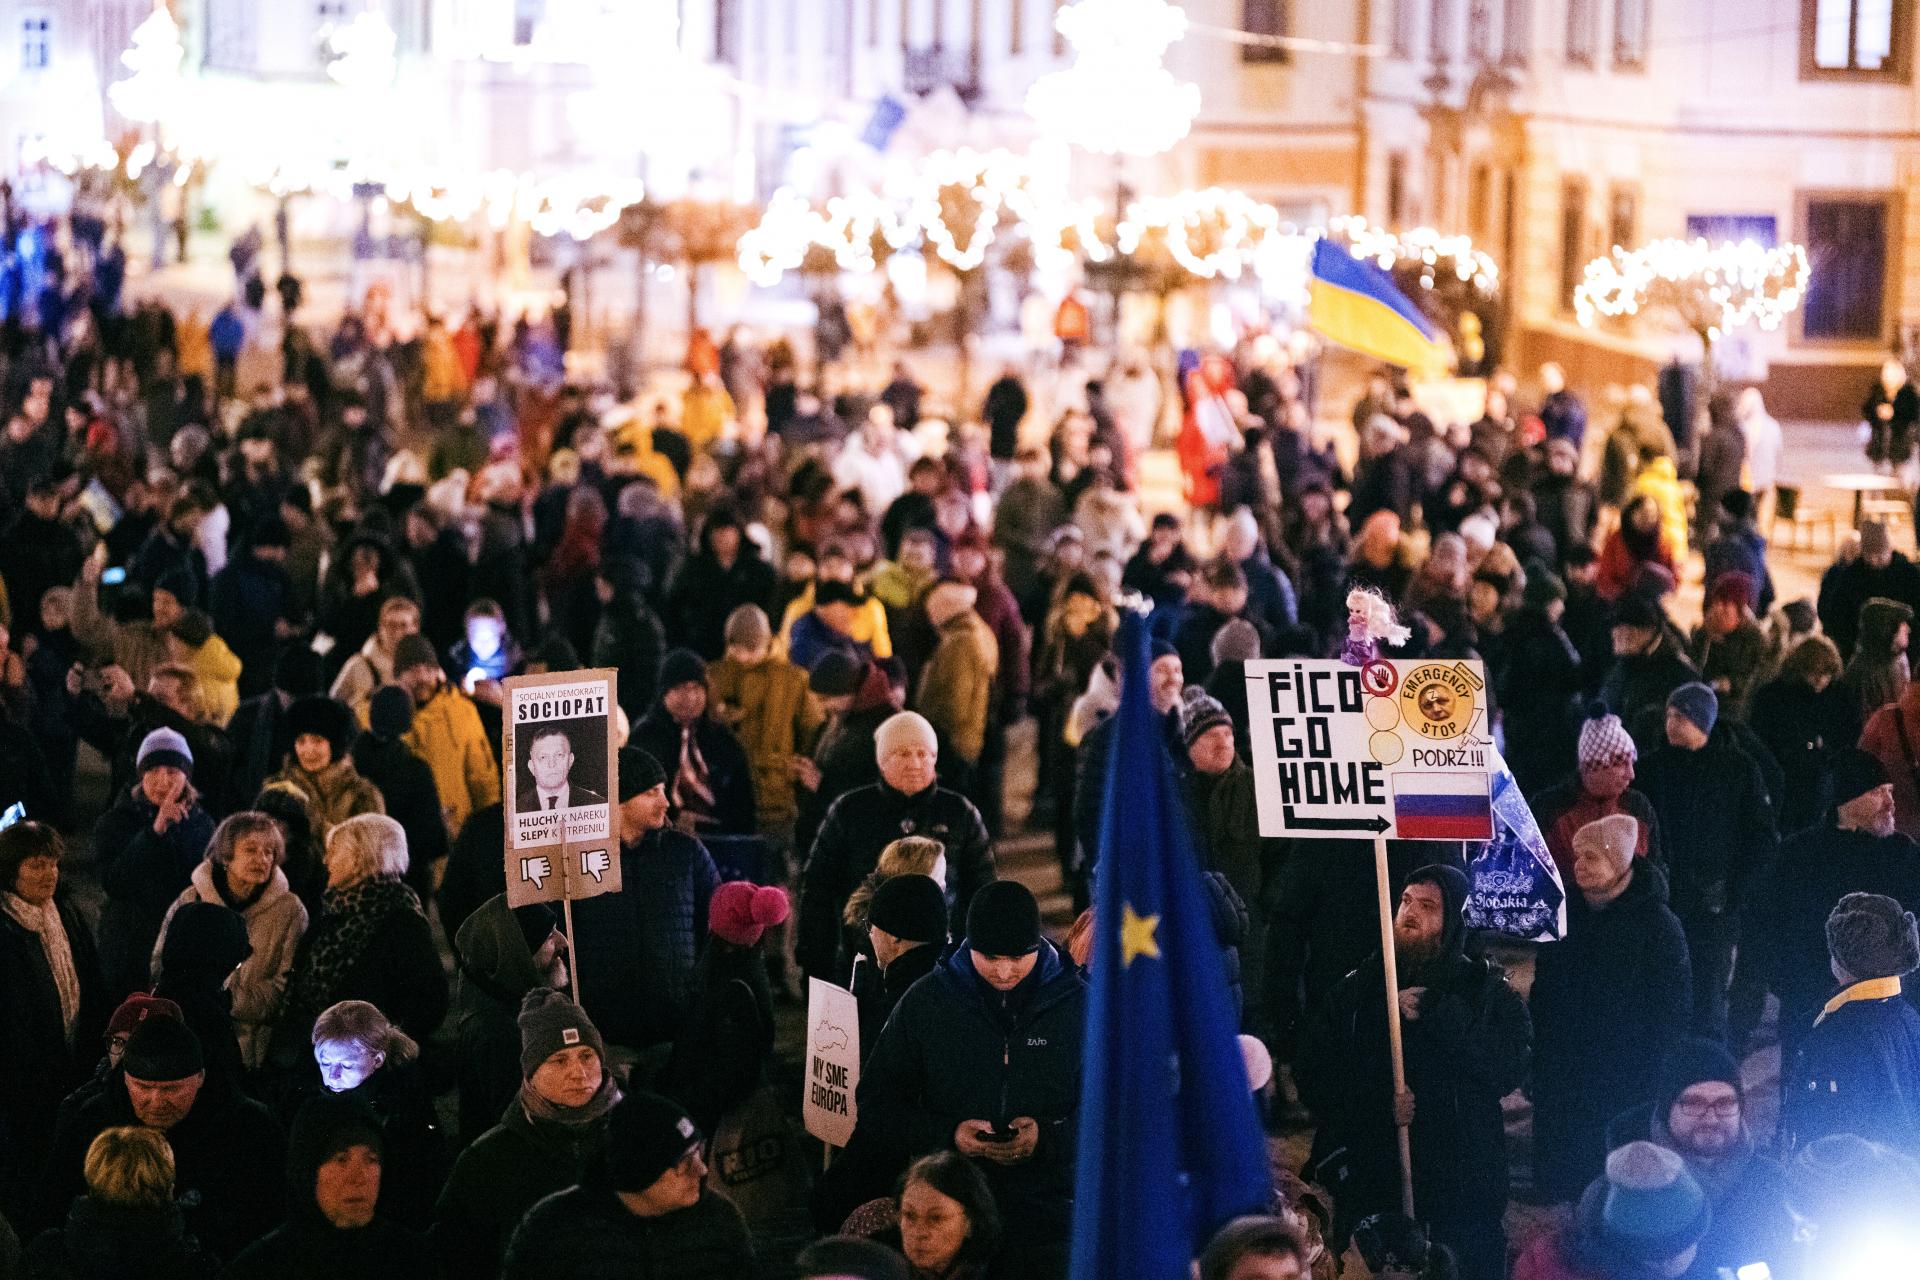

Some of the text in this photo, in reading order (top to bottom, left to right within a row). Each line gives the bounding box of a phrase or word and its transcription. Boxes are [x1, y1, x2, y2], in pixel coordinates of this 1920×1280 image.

[1403, 668, 1470, 700] EMERGENCY
[518, 696, 604, 721] SOCIOPAT
[1272, 716, 1332, 758] GO
[1421, 721, 1456, 737] STOP
[1278, 761, 1386, 805] HOME
[519, 812, 559, 828] HLUCHÝ
[561, 814, 567, 822] K
[520, 827, 549, 841] SLEPÝ
[551, 829, 557, 838] K
[813, 1055, 848, 1090] MY SME
[811, 1082, 848, 1117] EURÓPA
